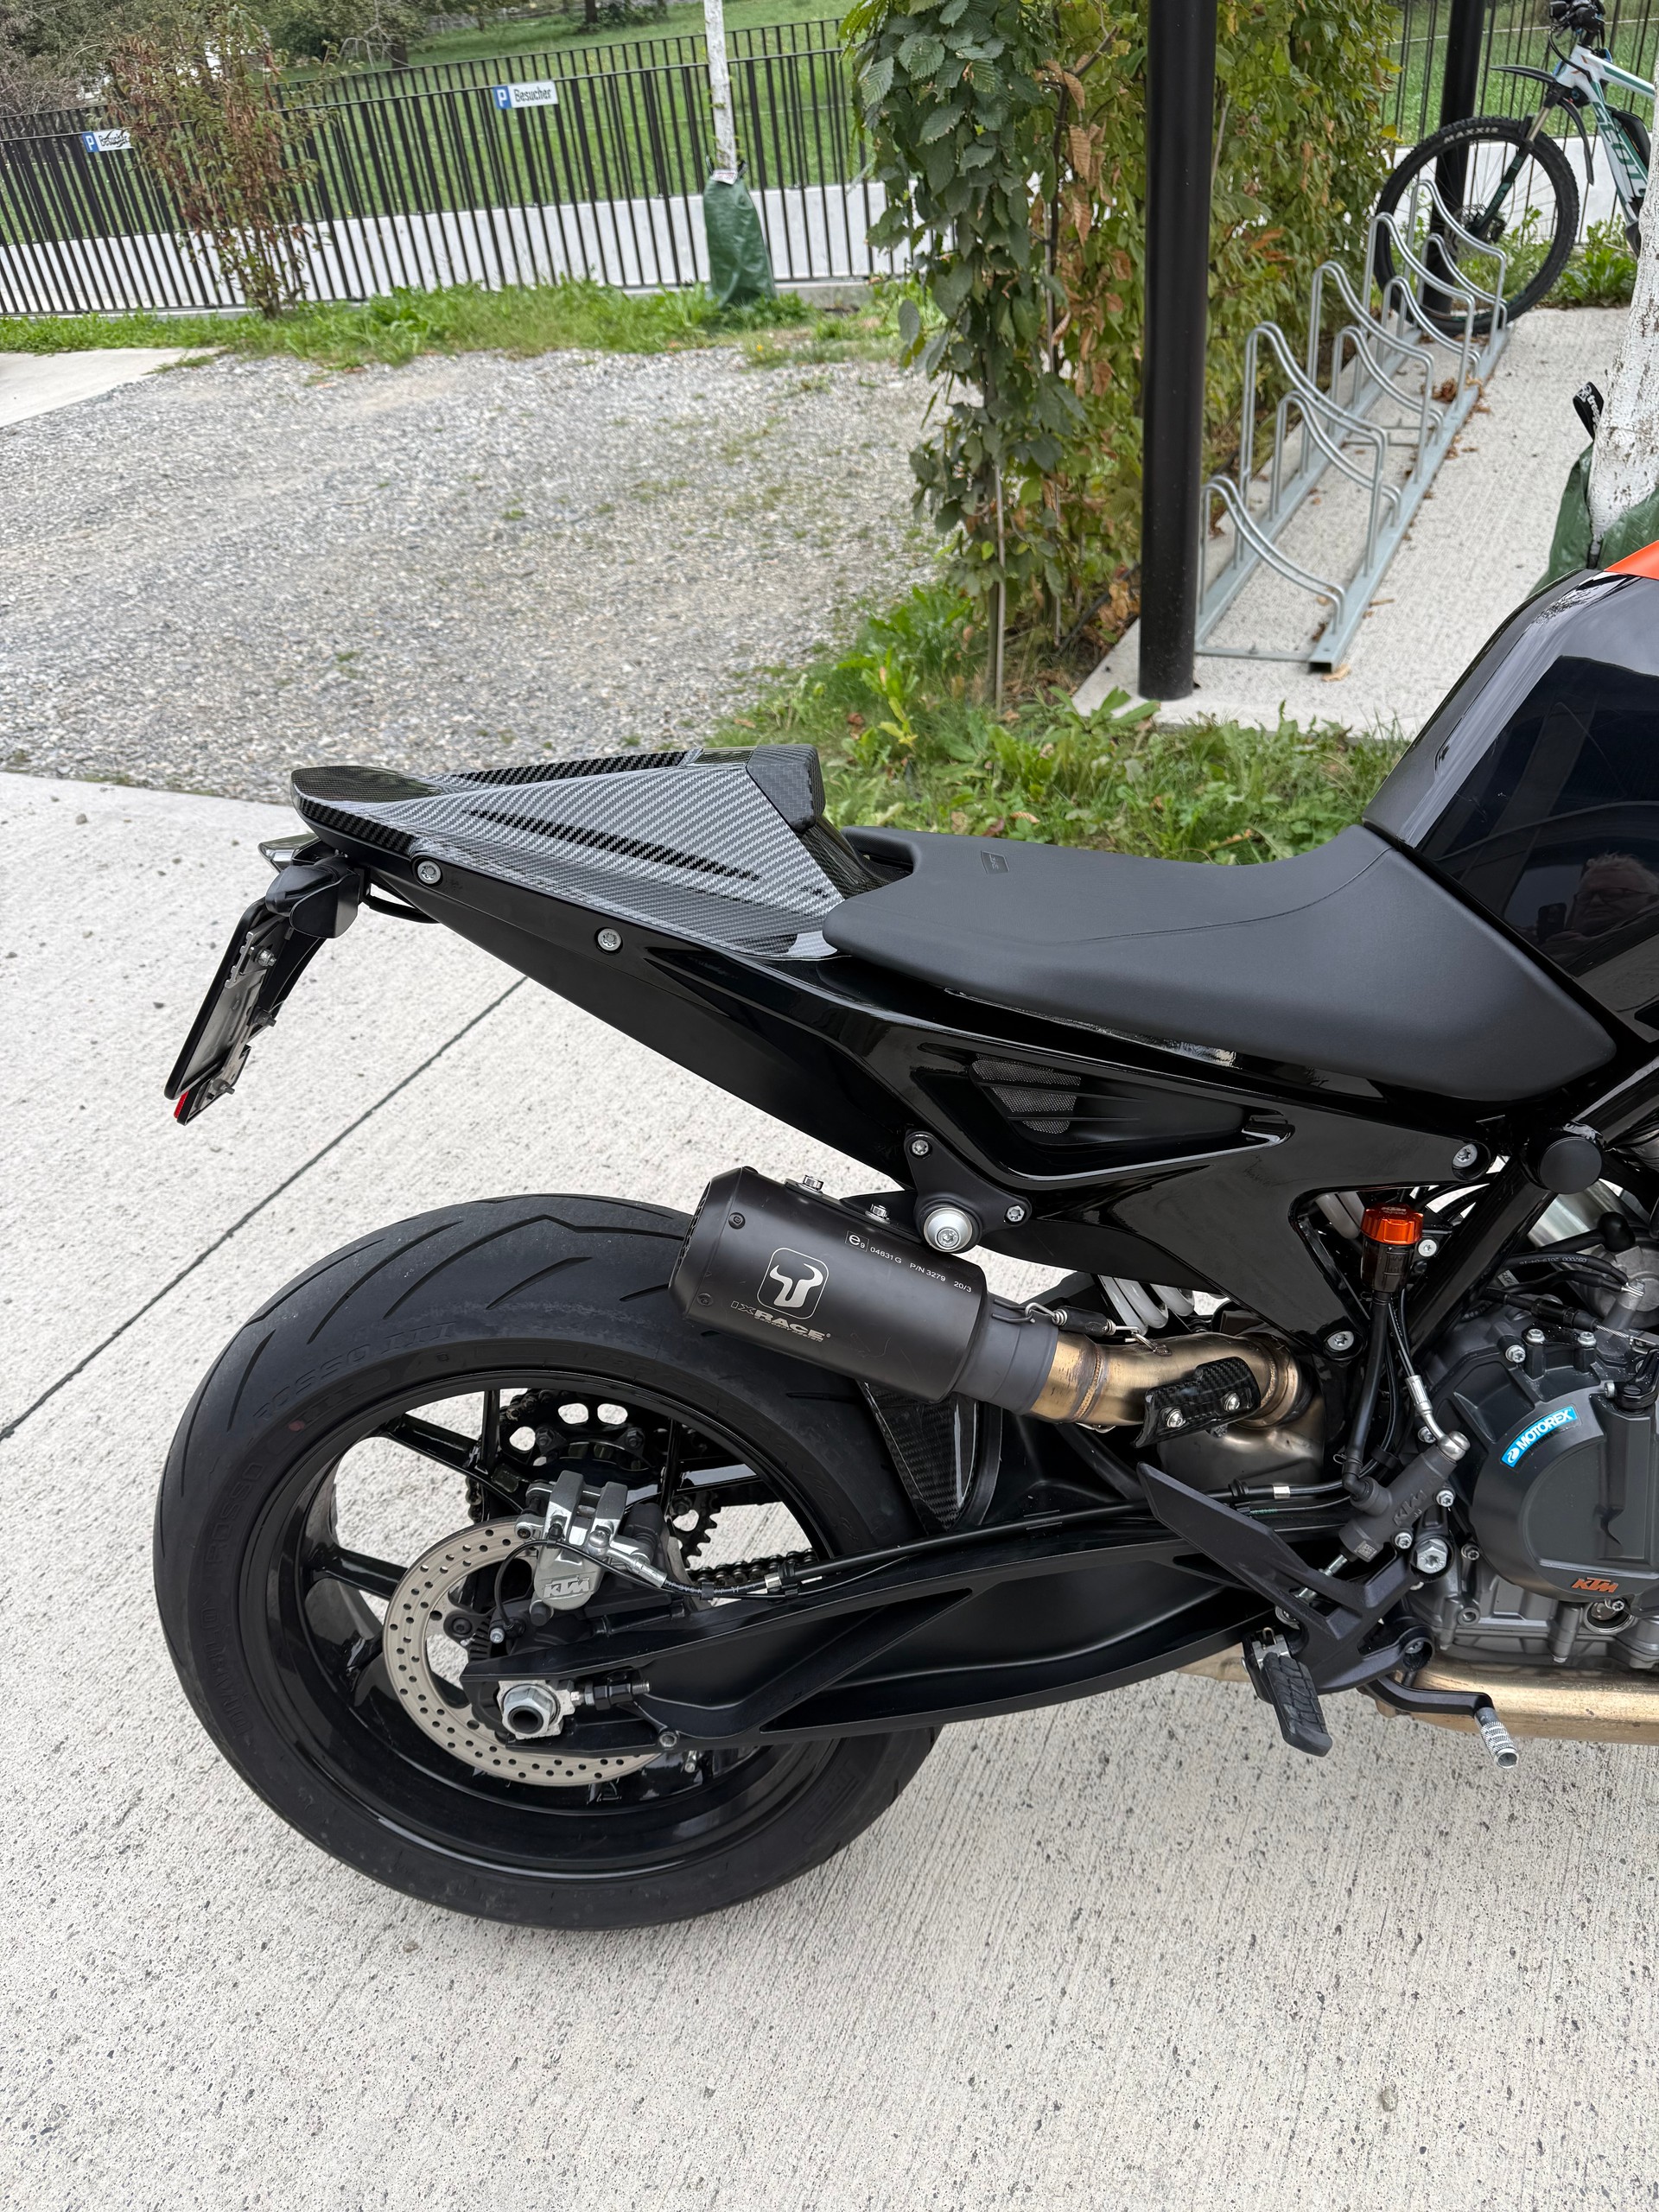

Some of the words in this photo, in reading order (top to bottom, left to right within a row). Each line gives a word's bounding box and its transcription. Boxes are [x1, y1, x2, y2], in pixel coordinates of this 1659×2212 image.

[496, 89, 508, 108] P
[513, 86, 551, 102] Besucher
[85, 135, 95, 151] P
[1444, 126, 1499, 144] MAXXIS
[910, 1262, 925, 1274] P/N
[926, 1269, 946, 1282] 3279
[1516, 1408, 1573, 1451] MOTOREX
[543, 1574, 591, 1599] KTM
[1572, 1576, 1619, 1593] KTM
